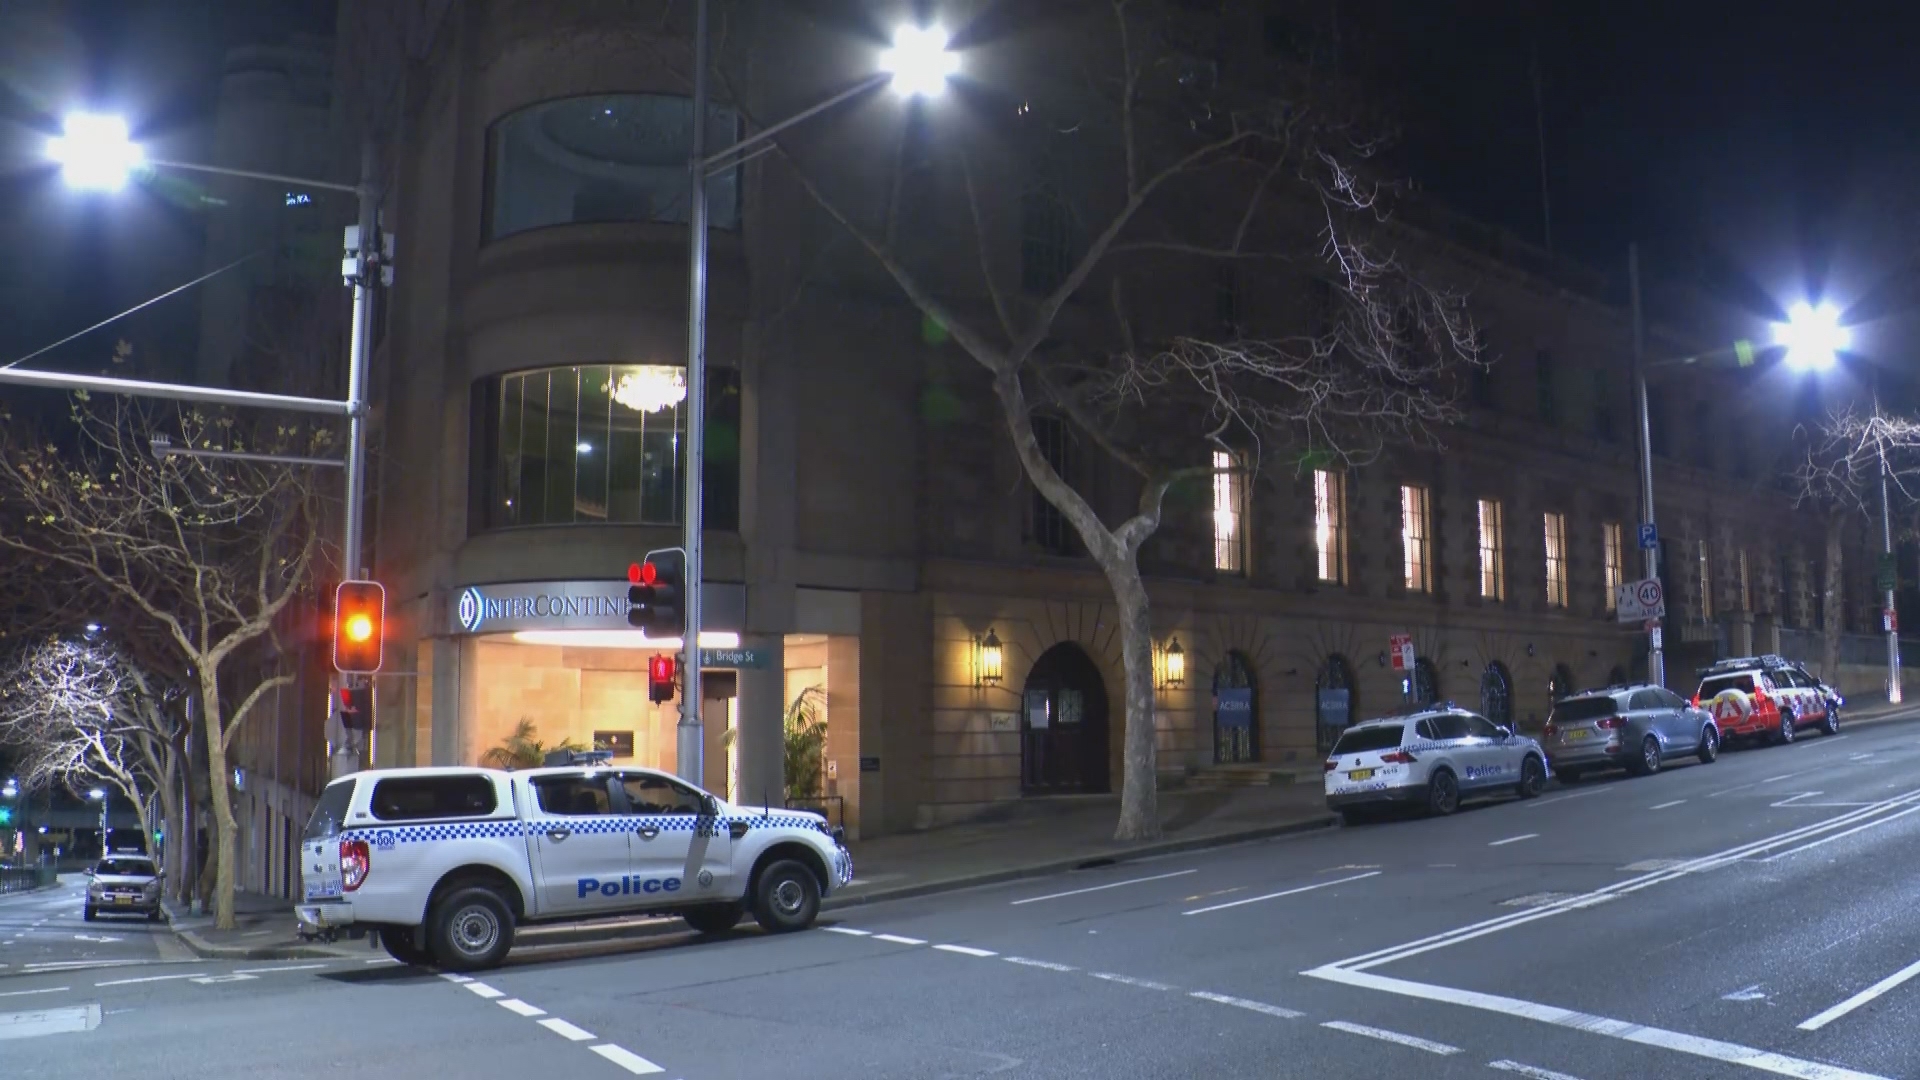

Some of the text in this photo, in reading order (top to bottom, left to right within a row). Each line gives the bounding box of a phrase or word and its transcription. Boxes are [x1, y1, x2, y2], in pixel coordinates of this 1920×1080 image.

[1642, 527, 1653, 540] P
[1642, 586, 1658, 600] 40
[1641, 606, 1664, 618] AREA
[716, 650, 754, 664] Bridge St
[1465, 764, 1502, 778] Police
[577, 874, 682, 898] Police
